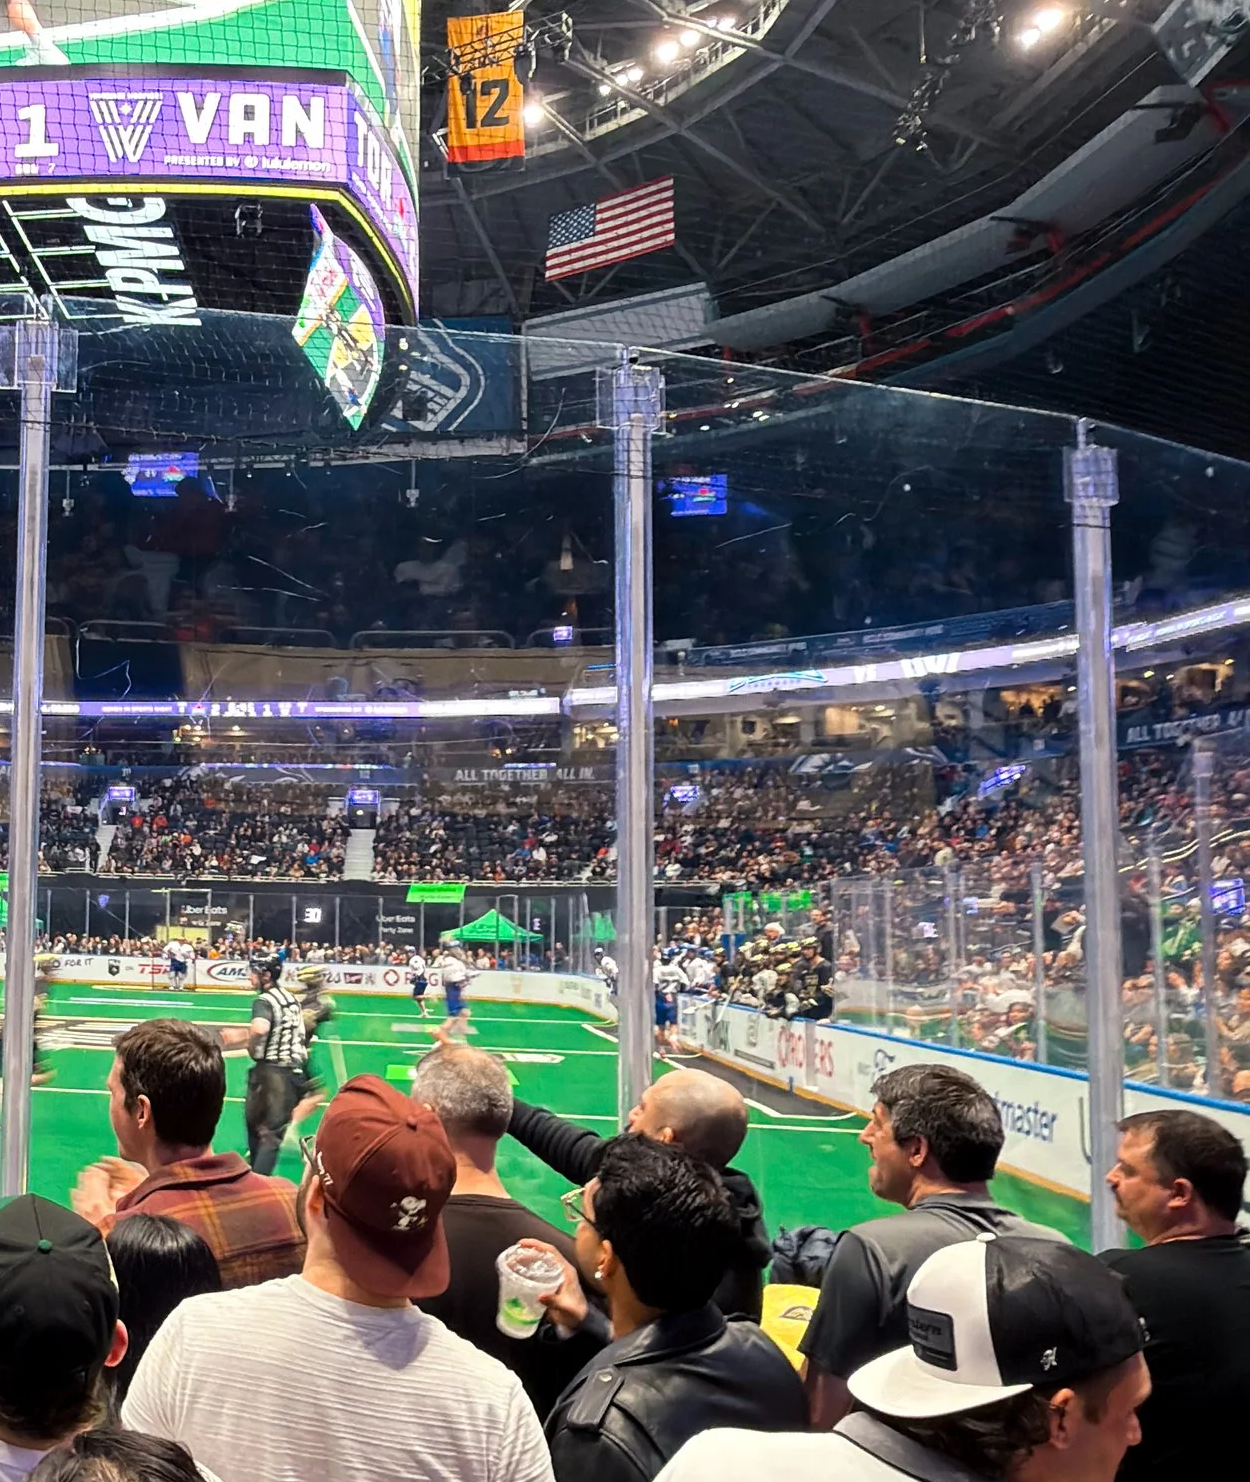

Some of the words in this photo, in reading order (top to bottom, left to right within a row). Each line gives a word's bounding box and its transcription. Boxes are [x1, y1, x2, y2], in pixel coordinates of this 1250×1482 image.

[175, 91, 327, 150] VAN
[465, 78, 510, 130] 12
[13, 104, 60, 158] 1
[164, 154, 218, 168] PRESENTED
[261, 155, 332, 172] lululemon
[454, 768, 478, 782] ALL
